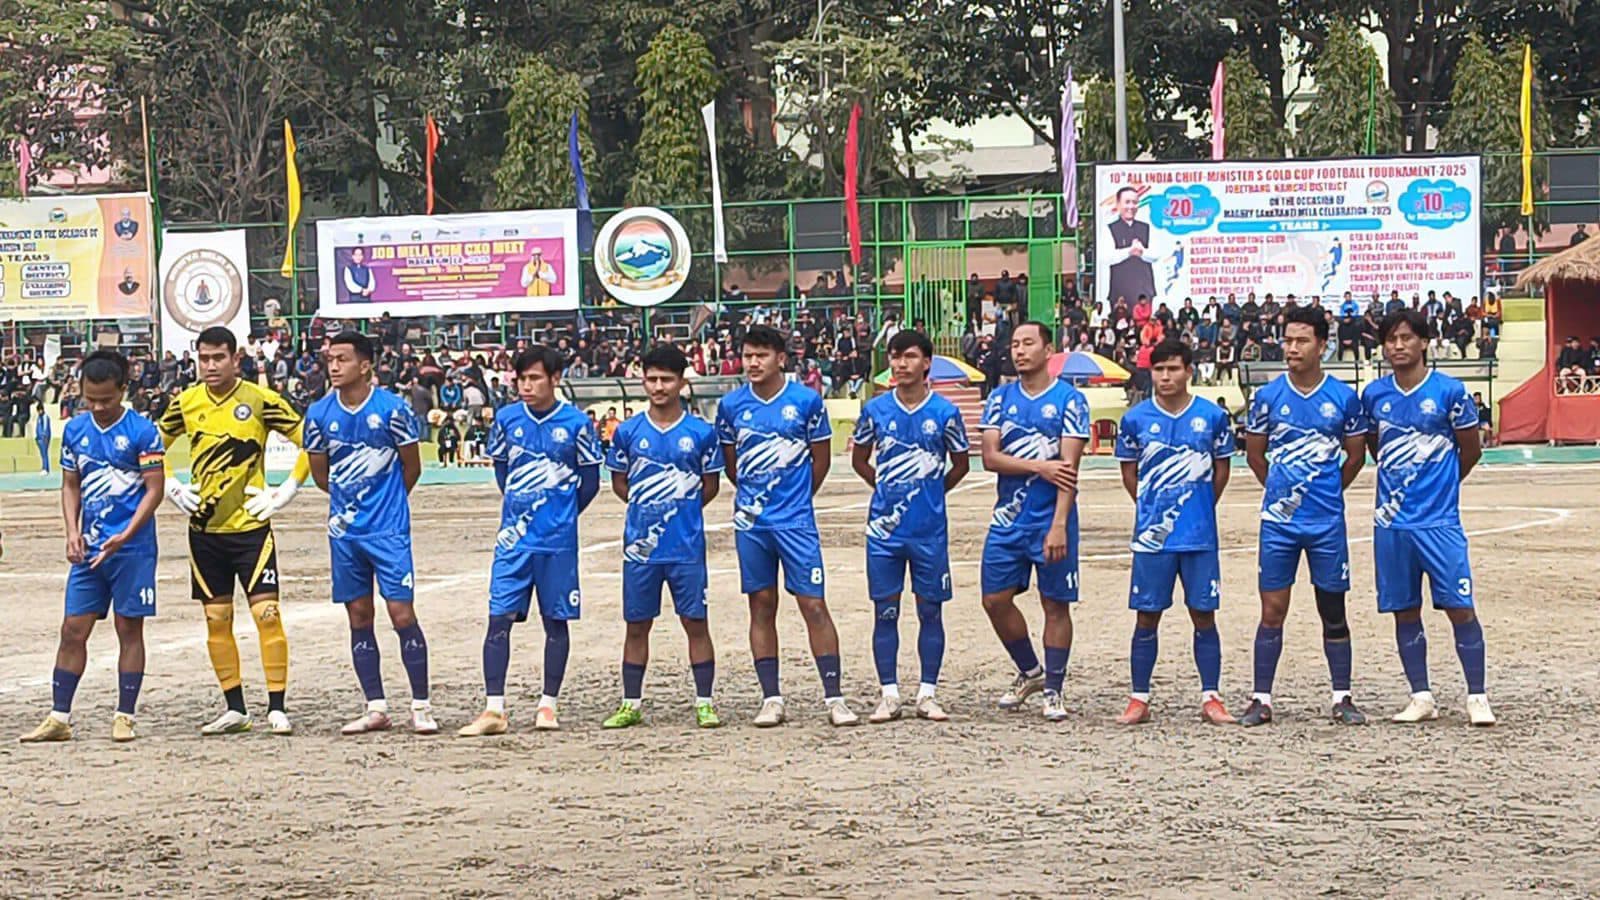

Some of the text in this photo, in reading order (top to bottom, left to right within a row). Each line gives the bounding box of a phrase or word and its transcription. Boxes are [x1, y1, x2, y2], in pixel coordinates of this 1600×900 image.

[1127, 172, 1142, 184] ALL
[1145, 172, 1173, 184] INDIA
[1266, 169, 1292, 181] GOLD
[1294, 168, 1315, 180] CUP
[1317, 167, 1365, 179] FOOTBALL
[1281, 196, 1294, 206] THE
[1296, 195, 1334, 205] OCCASION
[1280, 220, 1319, 231] TEAMS
[8, 254, 50, 262] TEAMS
[262, 569, 276, 584] 22
[401, 572, 413, 589] 4
[811, 567, 822, 584] 8
[1066, 571, 1079, 589] 11
[1458, 578, 1471, 595] 3
[140, 587, 154, 605] 19
[568, 590, 580, 606] 6
